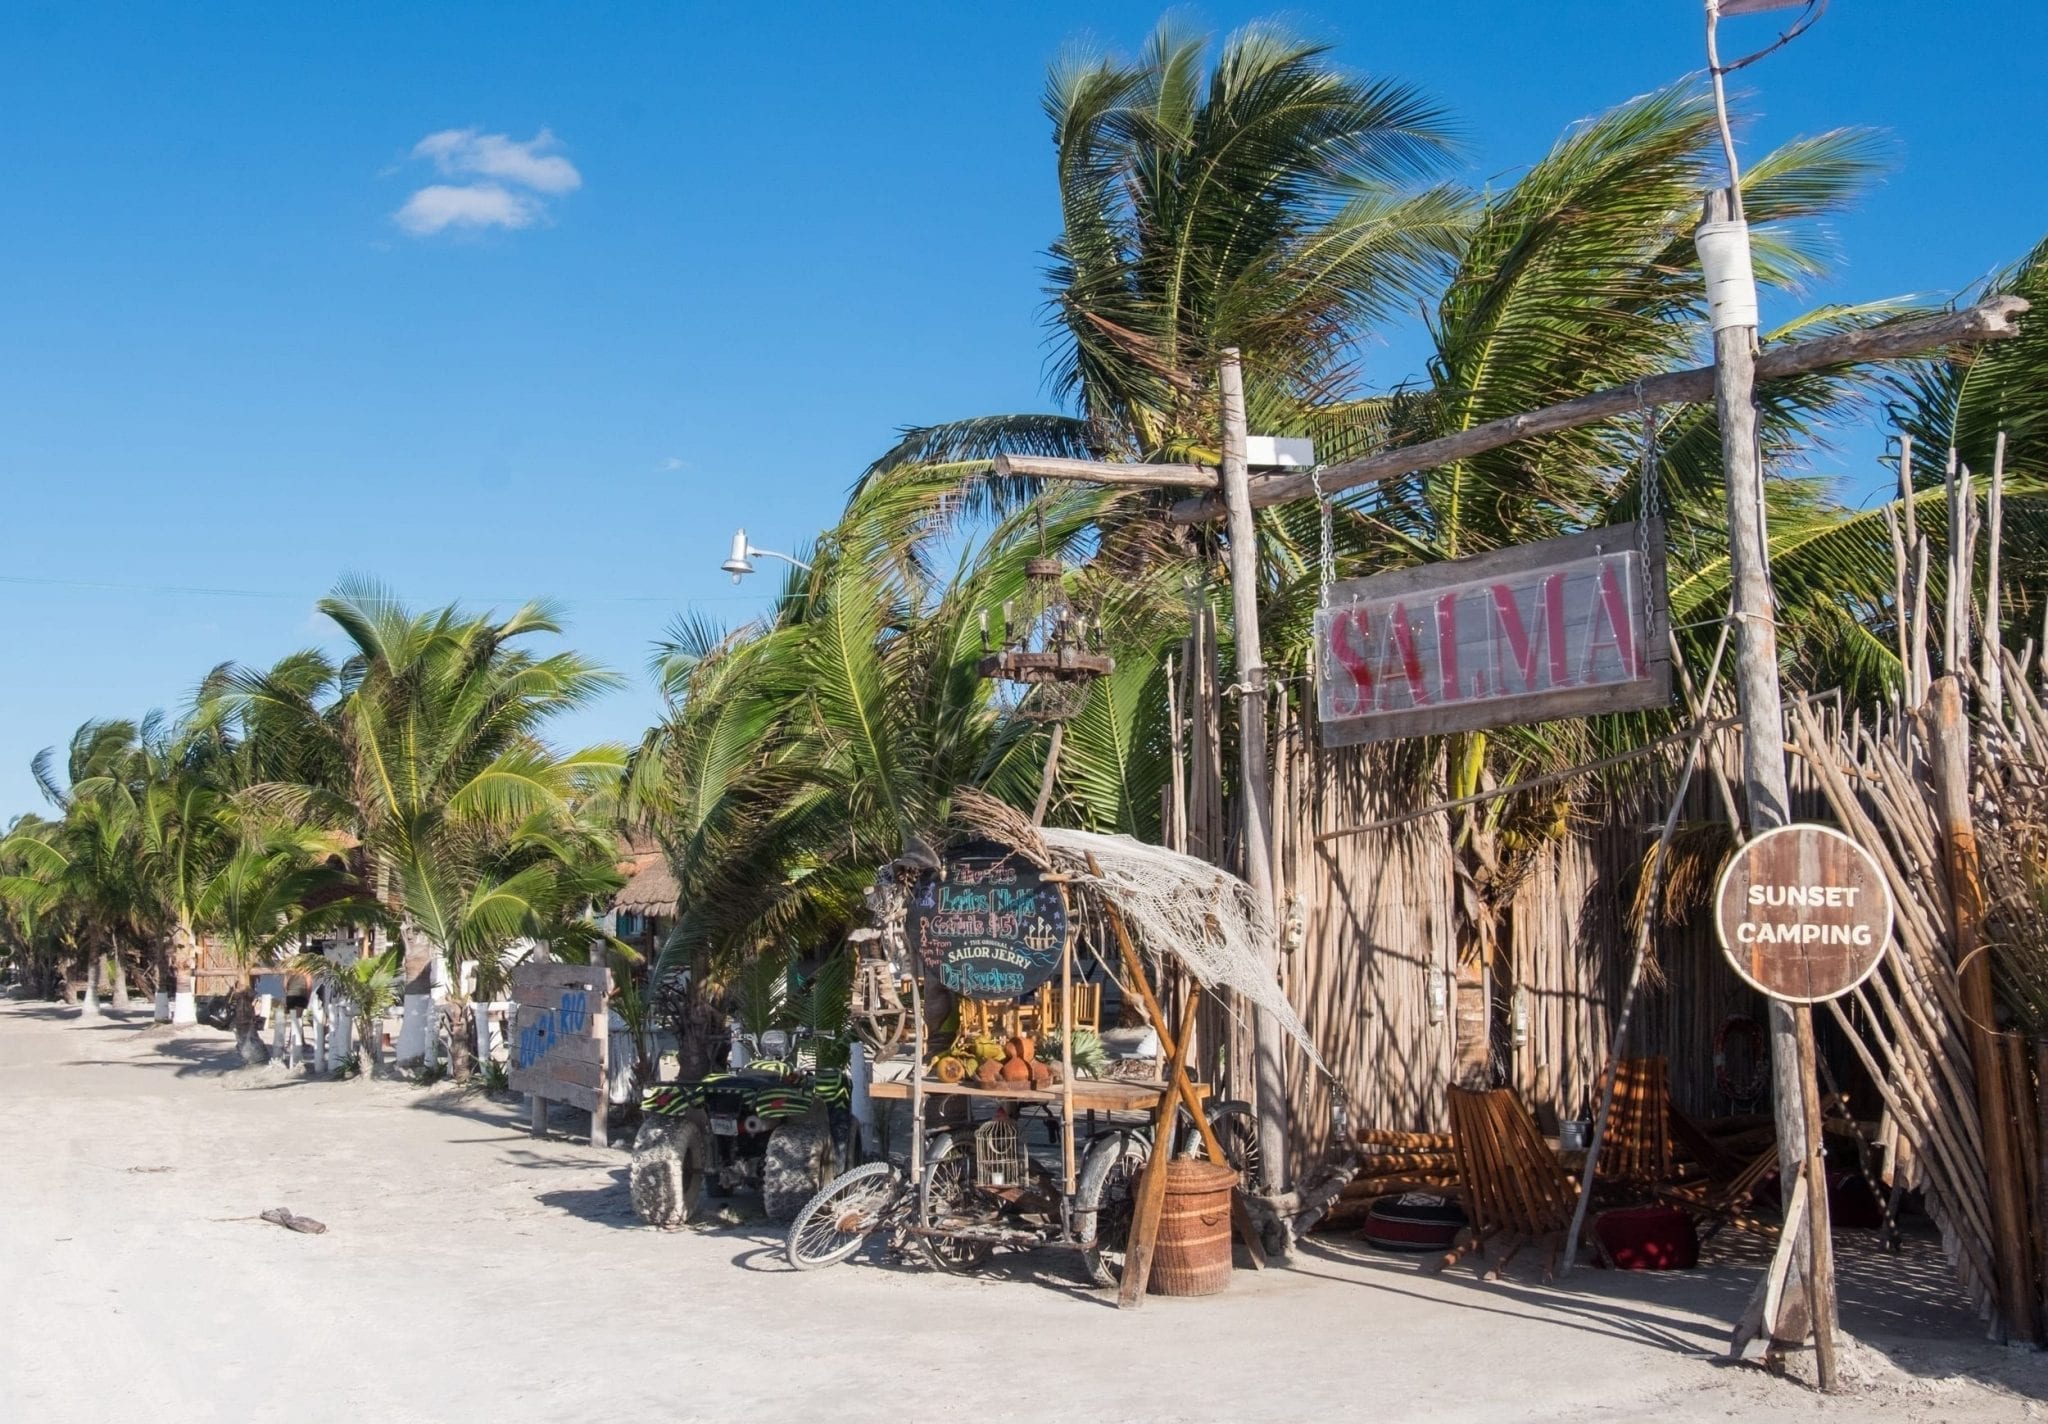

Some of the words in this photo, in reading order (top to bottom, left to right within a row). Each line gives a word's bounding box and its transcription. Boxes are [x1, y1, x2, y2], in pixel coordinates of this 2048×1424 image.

[1328, 560, 1649, 718] SALMA
[1748, 884, 1860, 908] SUNSET
[981, 939, 1008, 950] ORIGINAL
[1736, 922, 1872, 945] CAMPING
[948, 946, 990, 963] SAILOR
[991, 947, 1032, 970] JERRY
[559, 991, 586, 1033] RIO
